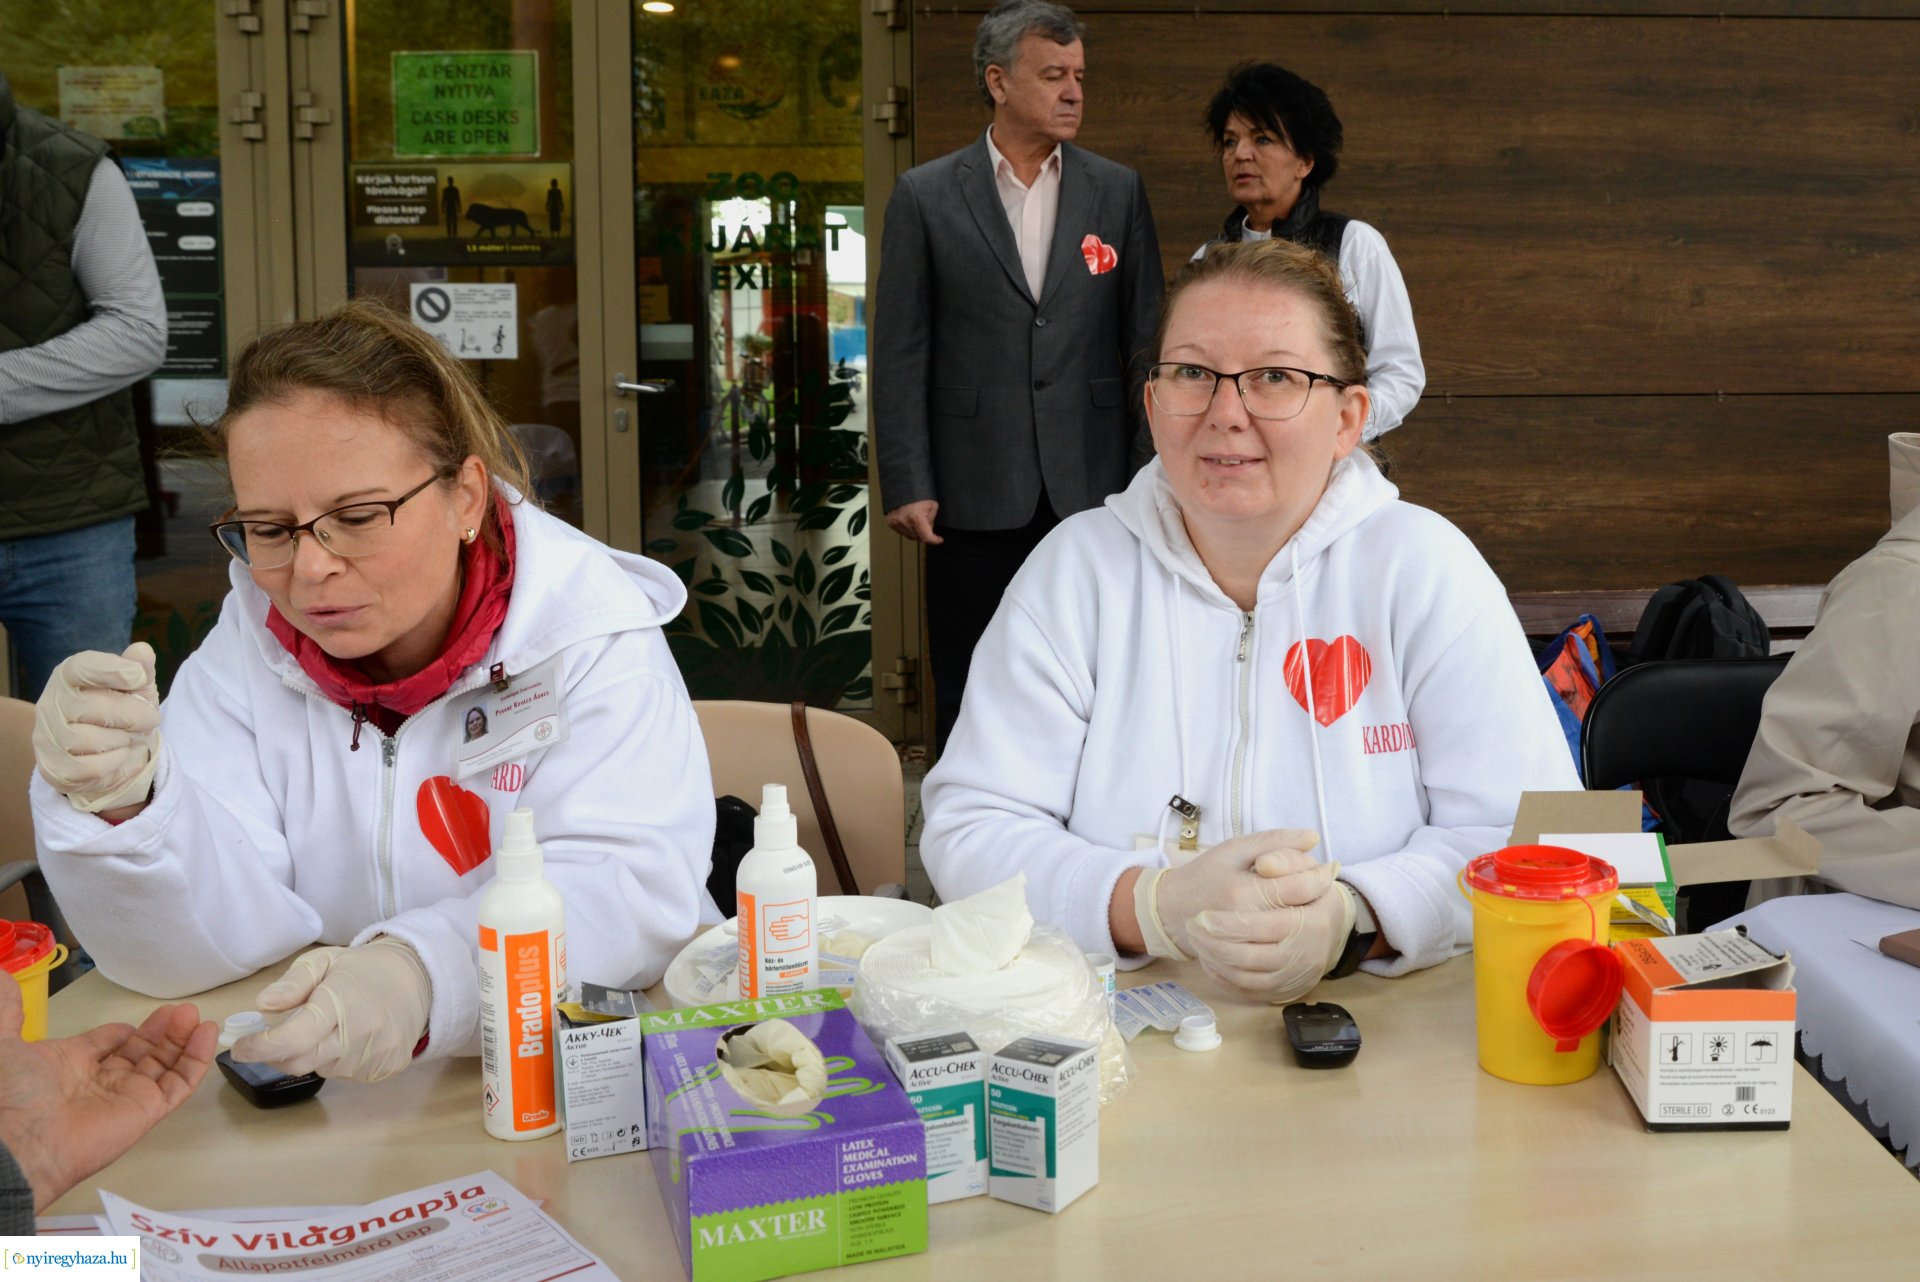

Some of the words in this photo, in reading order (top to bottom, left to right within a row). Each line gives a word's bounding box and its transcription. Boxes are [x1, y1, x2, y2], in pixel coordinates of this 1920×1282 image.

[434, 84, 496, 99] NYITVA
[411, 110, 457, 125] CASH
[463, 110, 520, 125] DESKS
[422, 130, 457, 145] ARE
[462, 129, 510, 145] OPEN
[706, 171, 799, 201] ZOO
[515, 944, 545, 1059] Bradoplus
[648, 993, 832, 1028] MAXTER
[909, 1060, 977, 1081] ACCU-CHEK
[991, 1062, 1050, 1084] ACCU-CHEK
[1058, 1055, 1095, 1081] ACCU-CHEK
[909, 1080, 932, 1088] Active
[1663, 1106, 1692, 1115] STERILE
[1697, 1106, 1708, 1115] EO
[842, 1139, 874, 1153] LATEX
[842, 1147, 890, 1163] MEDICAL
[843, 1153, 918, 1174] EXAMINATION
[843, 1170, 883, 1185] GLOVES
[131, 1212, 219, 1248] Szív
[232, 1185, 486, 1251] Világnapja
[698, 1207, 827, 1250] MAXTER
[218, 1236, 392, 1274] Állapotfelmérő
[396, 1223, 432, 1241] lap
